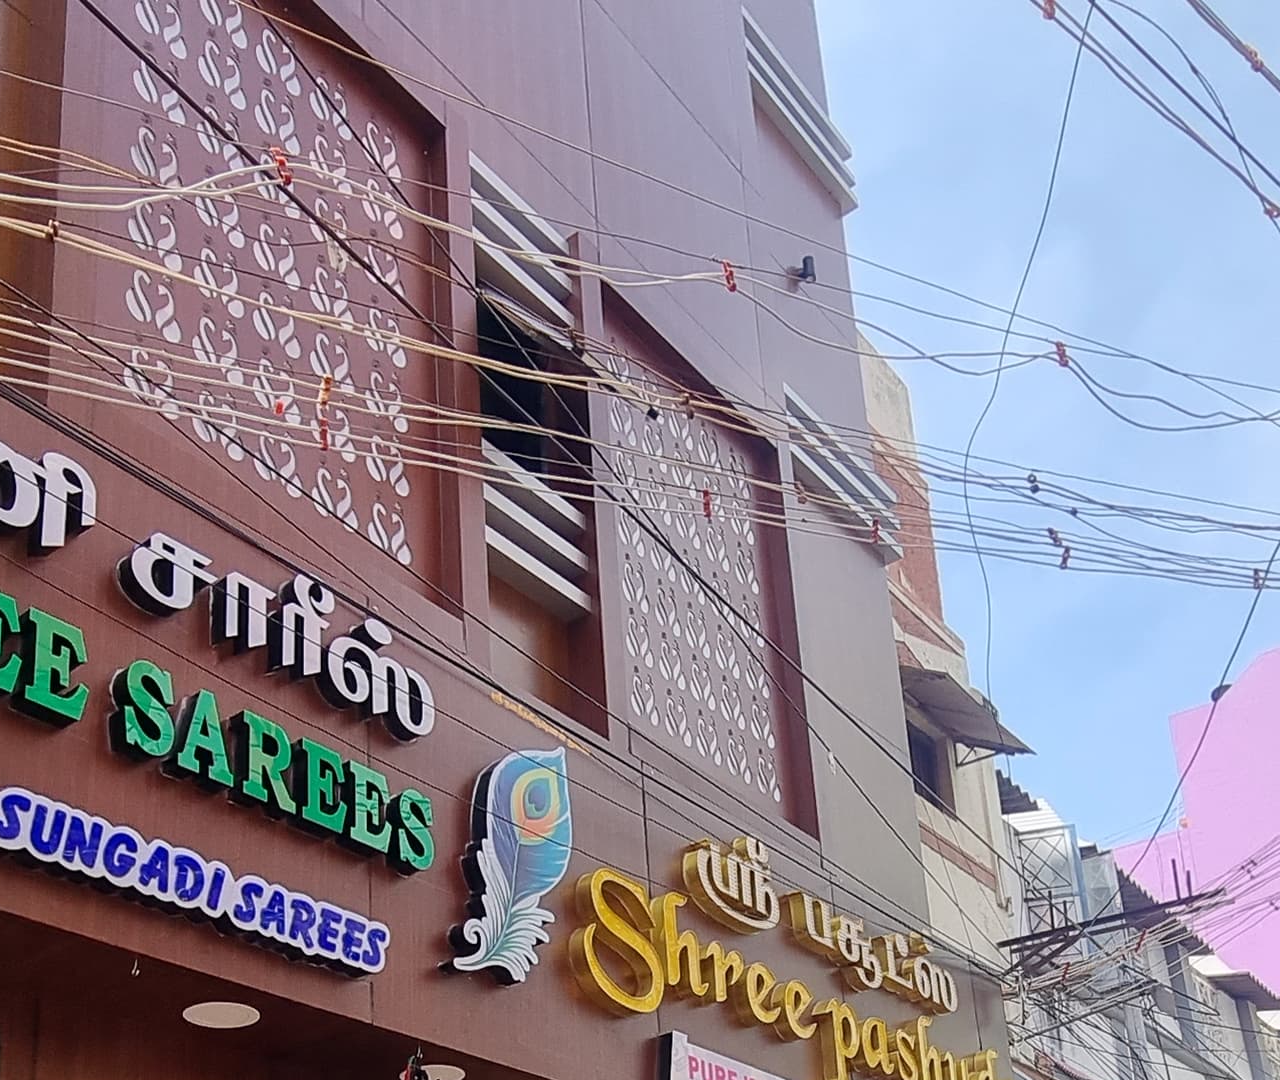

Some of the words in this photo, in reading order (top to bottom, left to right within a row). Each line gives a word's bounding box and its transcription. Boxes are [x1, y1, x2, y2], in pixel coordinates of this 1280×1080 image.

[131, 531, 436, 737] சாரீஸ்
[121, 660, 436, 872] SAREES
[233, 881, 387, 968] SAREES
[582, 868, 816, 1039] Shree
